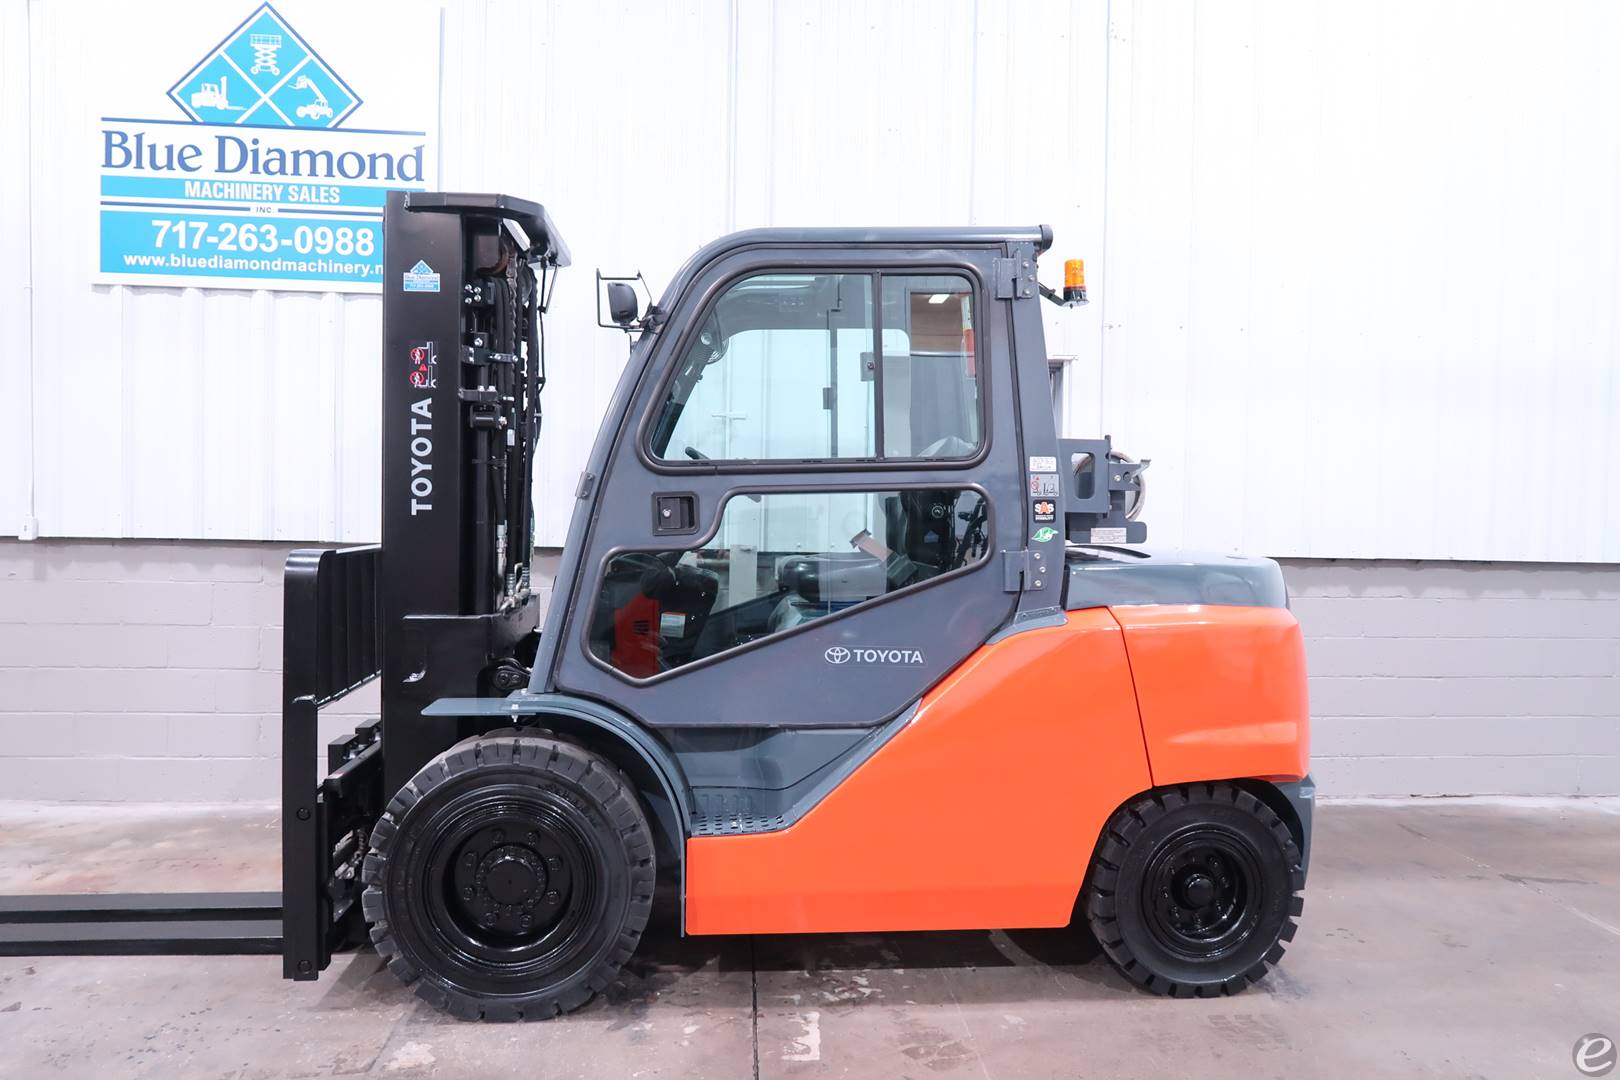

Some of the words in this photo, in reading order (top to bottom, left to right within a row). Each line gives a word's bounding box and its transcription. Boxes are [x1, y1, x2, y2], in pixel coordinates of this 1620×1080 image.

[102, 130, 202, 171] Blue
[215, 135, 424, 181] Diamond
[185, 181, 283, 201] MACHINERY
[289, 185, 340, 203] SALES
[153, 220, 375, 256] 717-263-0988
[411, 397, 433, 516] TOYOTA
[1034, 501, 1055, 515] SAS
[854, 650, 923, 664] TOYOTA
